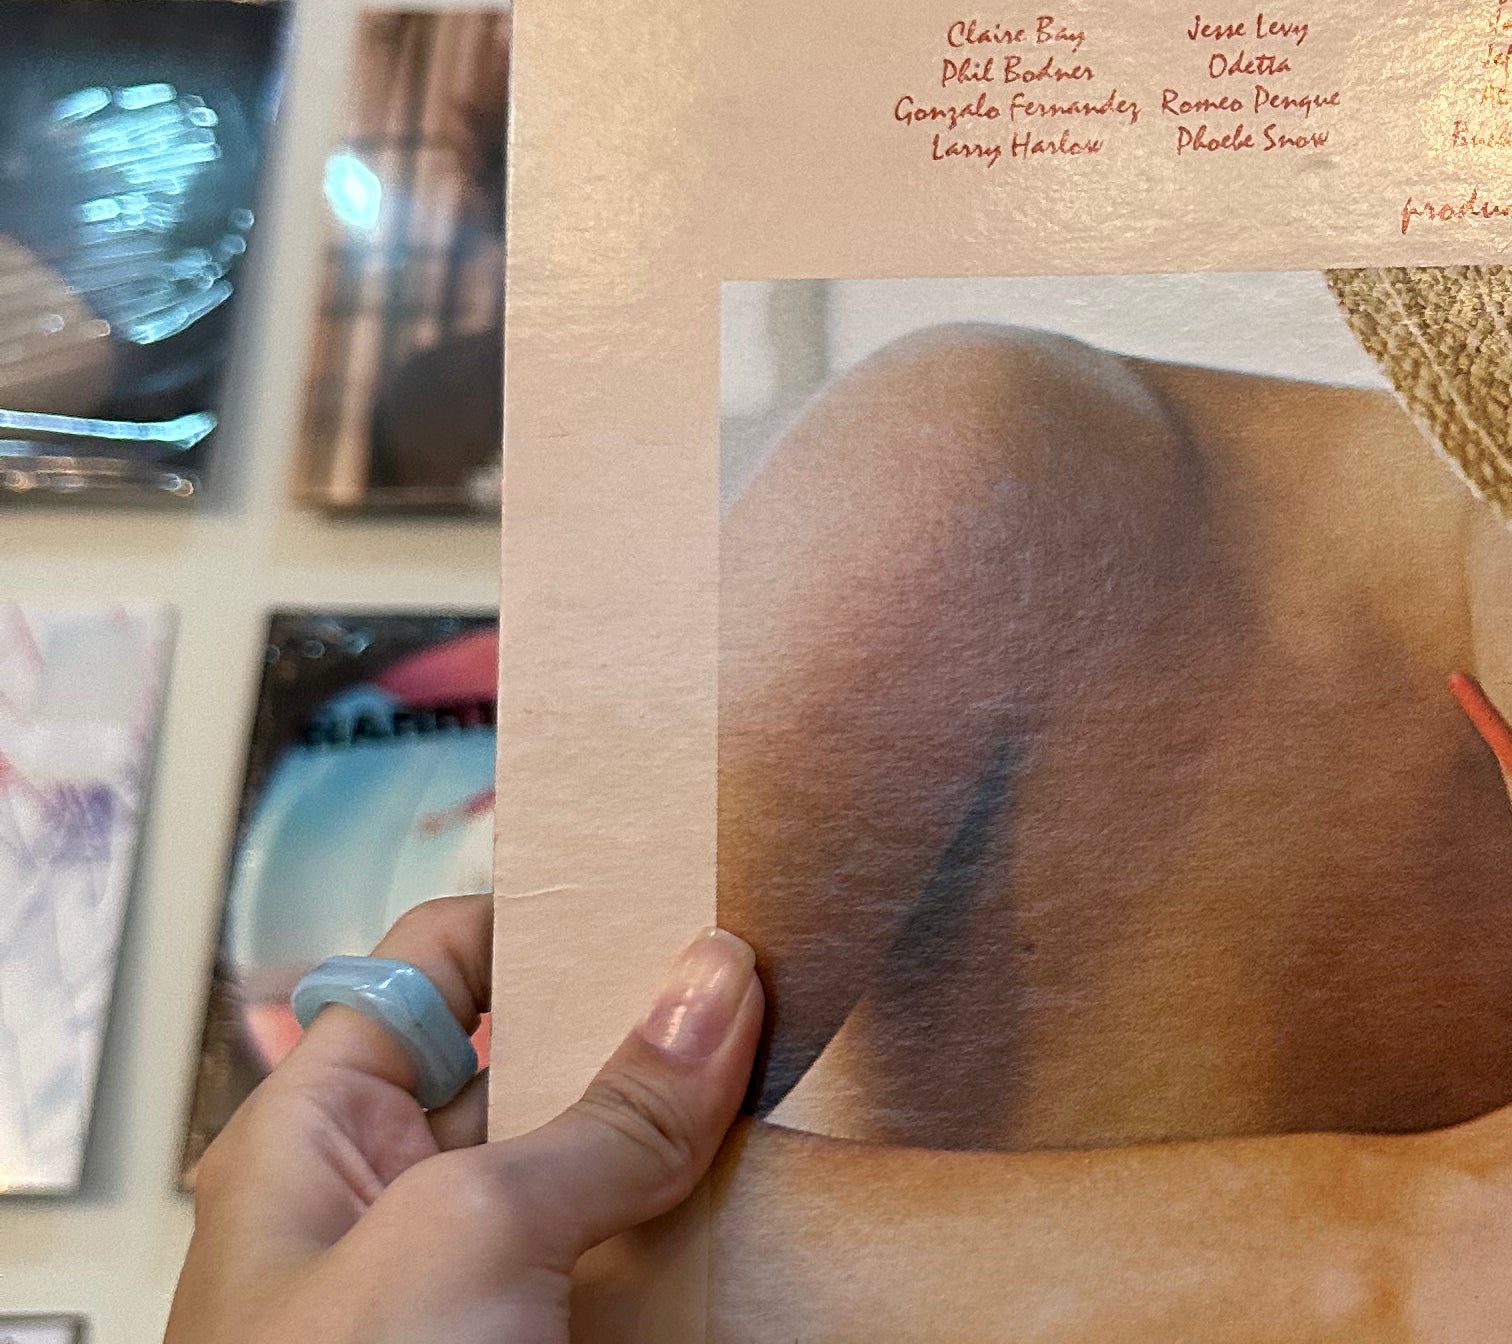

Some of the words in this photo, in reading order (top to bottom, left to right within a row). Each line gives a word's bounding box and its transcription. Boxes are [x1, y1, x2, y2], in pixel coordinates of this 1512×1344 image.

[947, 20, 1025, 49] Claire
[1036, 16, 1086, 53] Bay
[1187, 18, 1246, 41] Jesse
[1256, 13, 1309, 46] Levy
[942, 58, 994, 87] Phil
[1004, 56, 1094, 84] Bodner
[1208, 53, 1291, 80] Odetta
[894, 93, 999, 129] Gonzalo
[1010, 90, 1141, 124] Fernandez
[1161, 88, 1242, 115] Romeo
[1254, 86, 1340, 116] Penque
[932, 133, 1001, 168] Larry
[1011, 130, 1104, 158] Harlow
[1176, 125, 1254, 154] Phoebe
[1263, 126, 1329, 151] Snow
